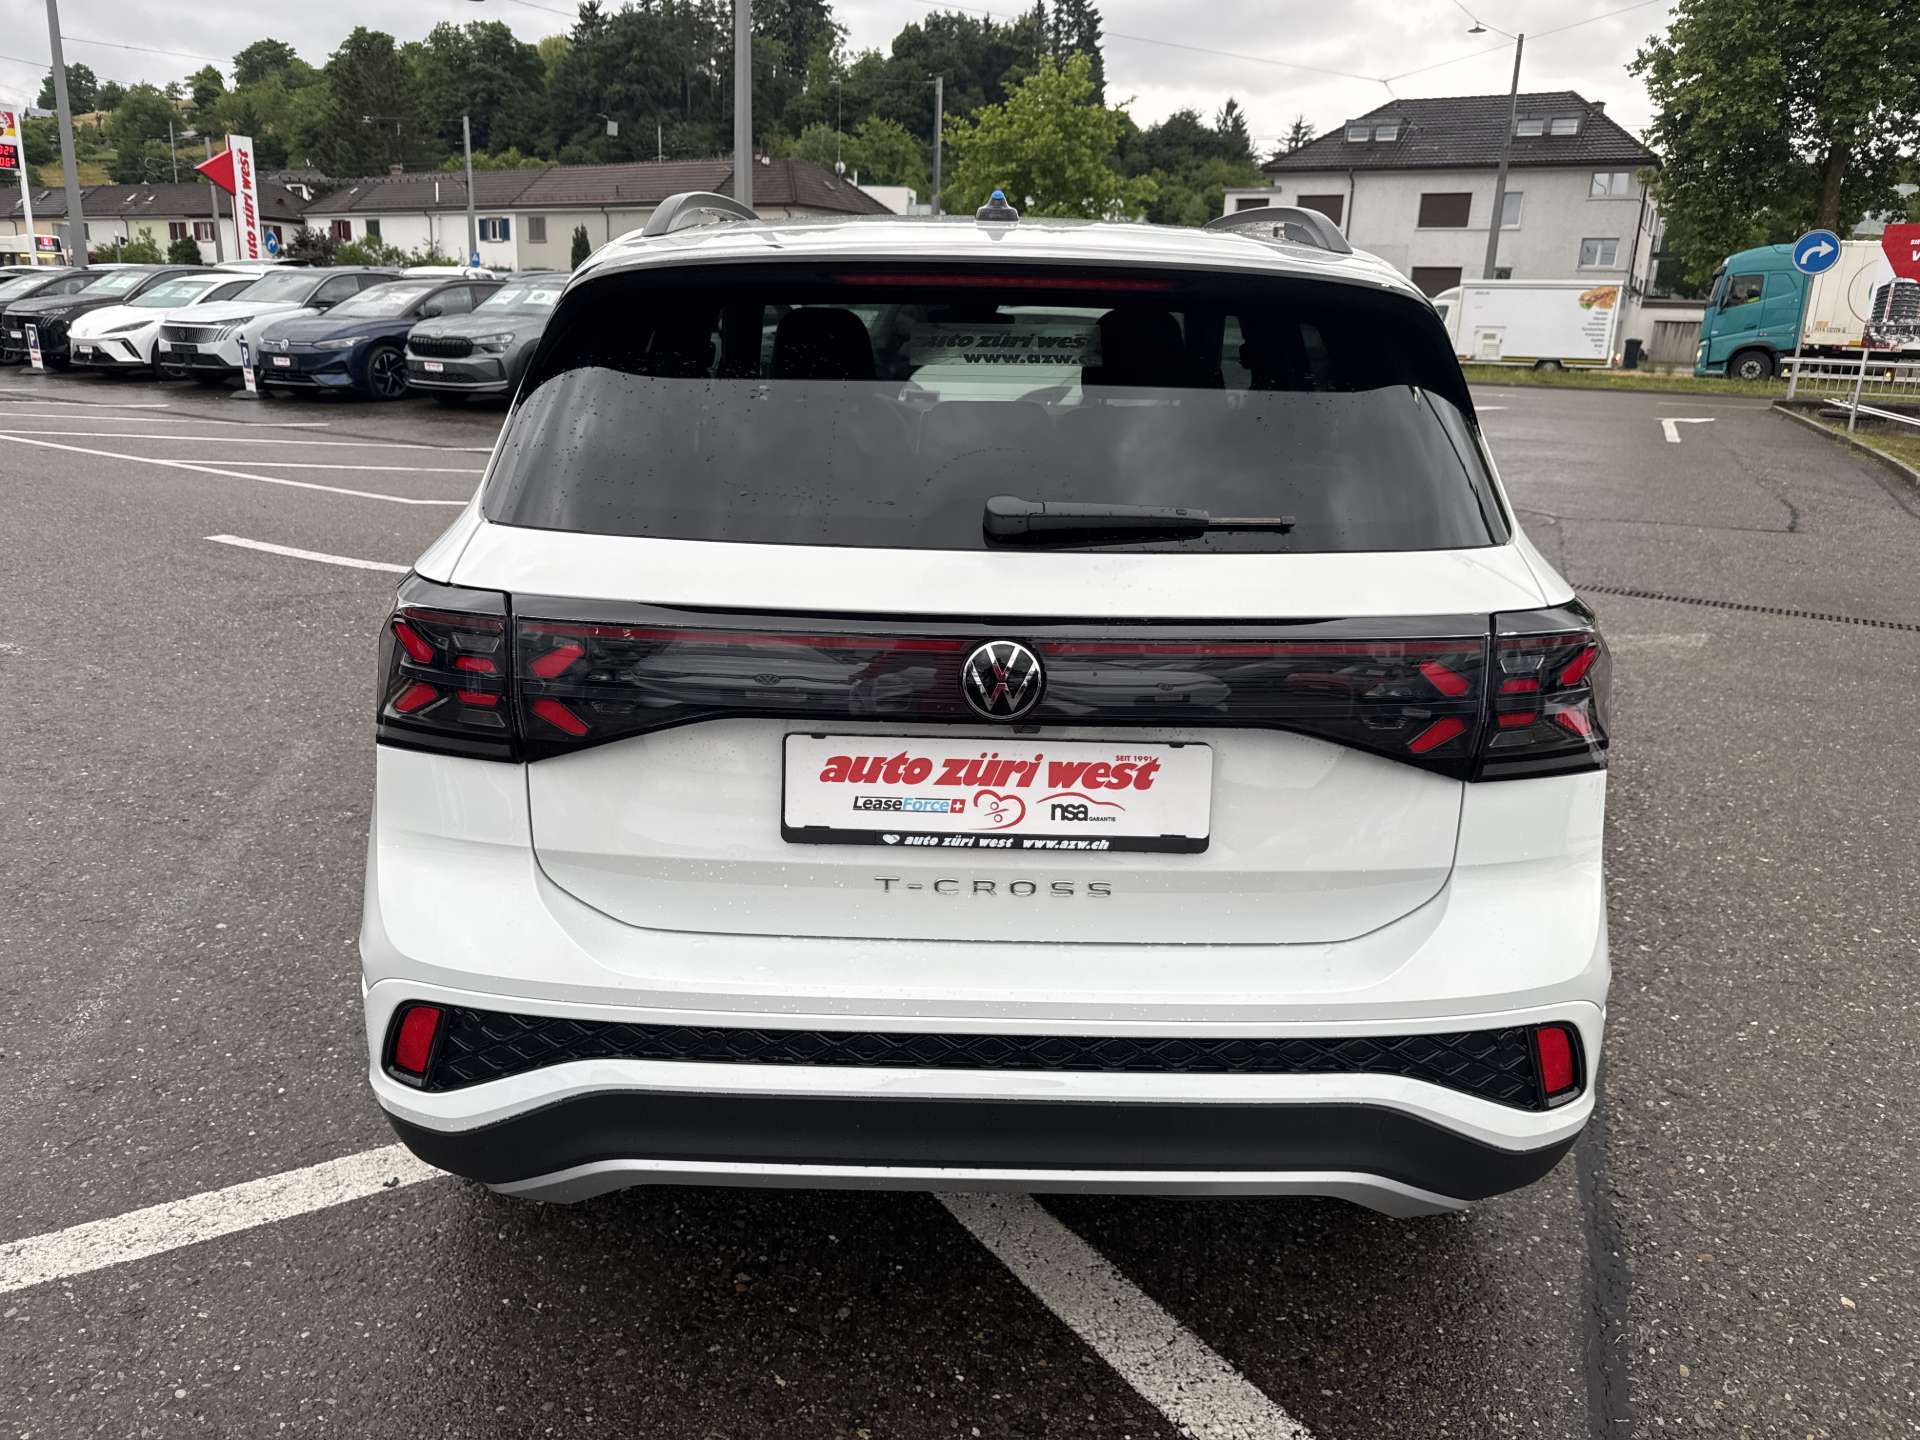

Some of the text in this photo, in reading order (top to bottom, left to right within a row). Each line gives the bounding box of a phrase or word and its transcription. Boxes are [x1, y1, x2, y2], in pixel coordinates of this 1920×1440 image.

[238, 148, 252, 189] west
[246, 231, 258, 260] uto
[242, 346, 249, 366] P
[1115, 754, 1131, 762] SEIT
[819, 751, 1161, 790] auto züri west
[853, 796, 950, 812] LeaseForce
[1050, 803, 1089, 822] nsa
[904, 834, 1111, 850] auto züri west www.azw.ch
[874, 875, 1113, 898] T-CROSS
